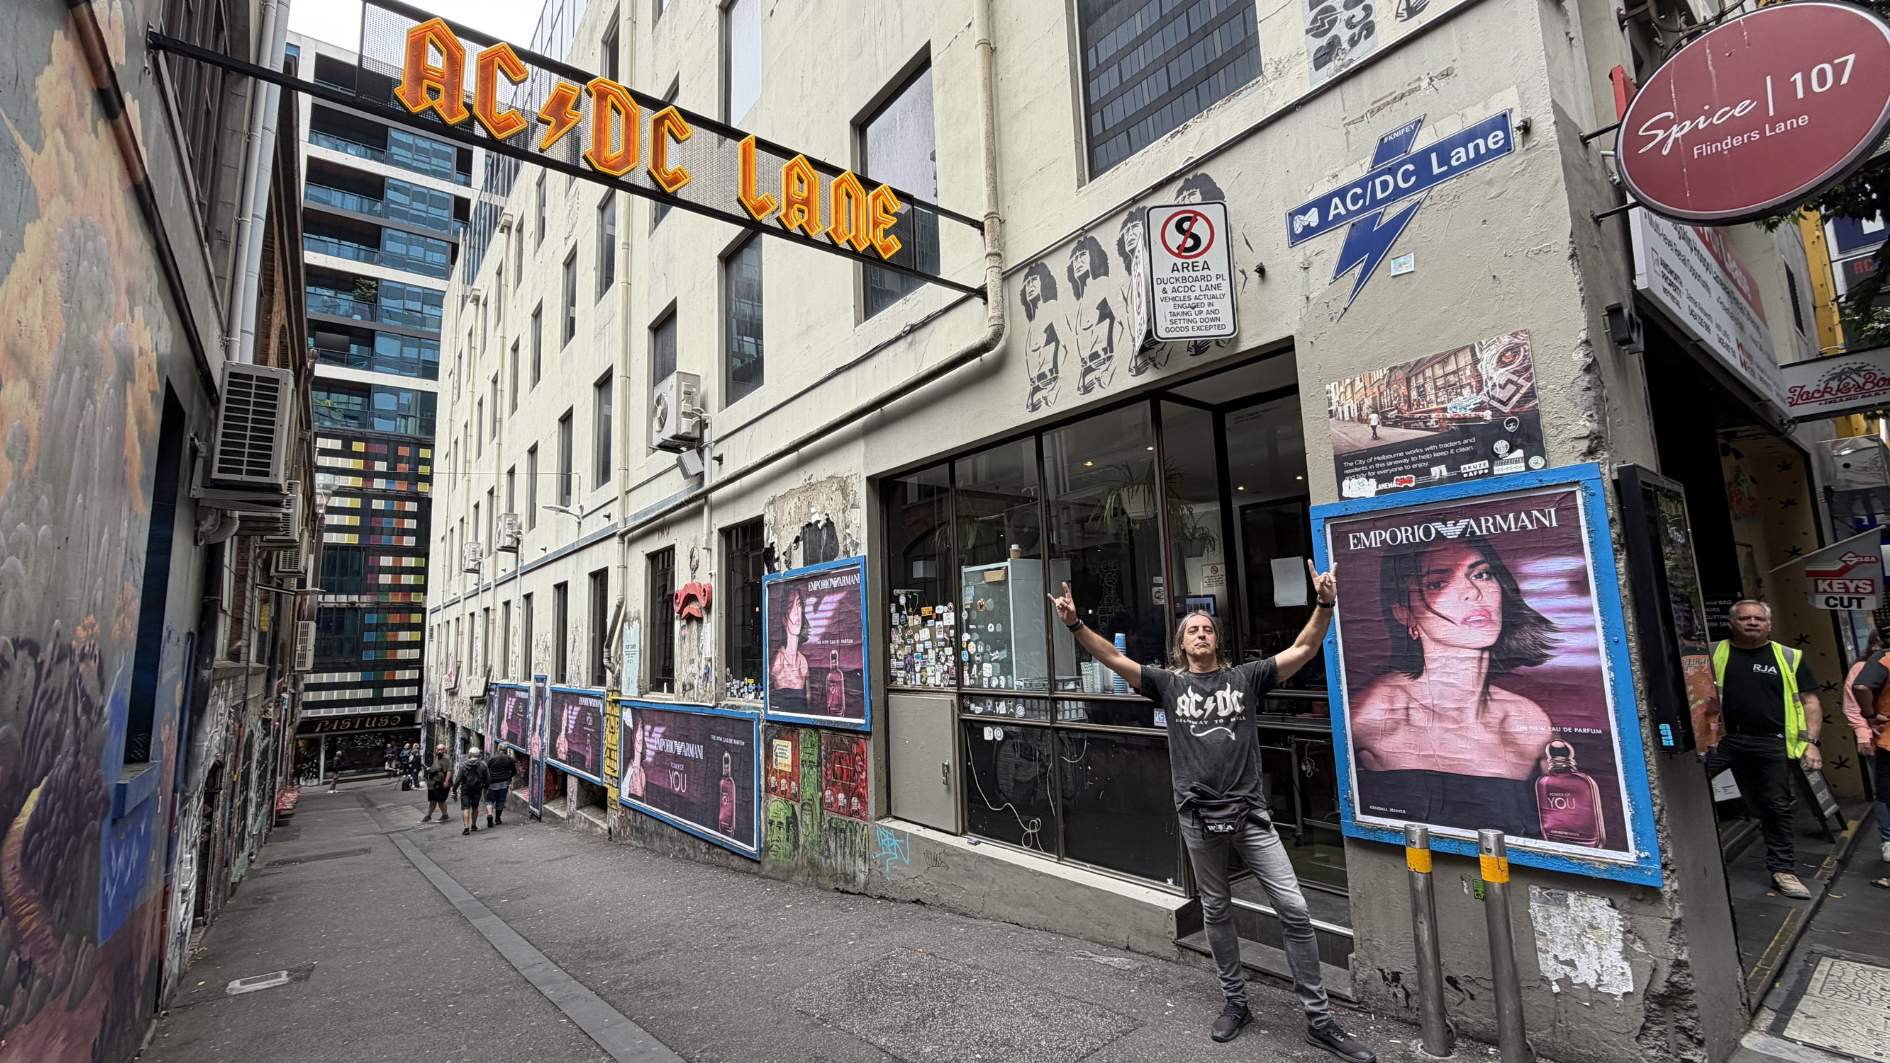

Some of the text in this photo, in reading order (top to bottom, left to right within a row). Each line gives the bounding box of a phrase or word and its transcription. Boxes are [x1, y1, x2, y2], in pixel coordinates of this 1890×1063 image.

[1637, 53, 1857, 156] Spice 107
[1382, 123, 1416, 144] #KNIFEY
[1693, 114, 1809, 159] Flinders Lane
[1327, 163, 1417, 221] AC/DC
[1430, 129, 1505, 175] Lane
[737, 134, 903, 261] LANE
[1171, 260, 1211, 273] AREA
[1156, 274, 1212, 285] DUCKBOARD
[1171, 284, 1196, 293] ACDC
[1199, 283, 1223, 292] LANE
[1160, 293, 1226, 303] VEHICLES ACTUALLY
[1173, 302, 1205, 310] ENGAGED
[1192, 324, 1226, 332] EXCEPTED
[1787, 382, 1838, 407] Jack
[1861, 371, 1890, 391] Bo
[1823, 396, 1859, 405] ISLAND
[1344, 466, 1369, 474] residents
[1386, 457, 1410, 467] laneway
[1419, 453, 1433, 461] help
[1433, 450, 1449, 458] keep
[1456, 445, 1474, 453] clean
[1354, 459, 1366, 467] City
[1373, 451, 1404, 462] Melbourne
[1405, 448, 1423, 456] works
[1424, 445, 1438, 453] with
[1438, 441, 1462, 449] traders
[1462, 437, 1476, 445] and
[1376, 466, 1404, 476] everyone
[1462, 462, 1487, 471] AKUZE
[1348, 508, 1559, 550] EMPORIO ARMANI
[808, 573, 860, 591] EMPORIO ARMANI
[1817, 579, 1873, 593] KEYS
[1825, 596, 1865, 609] CUT
[1753, 663, 1777, 674] RJA
[314, 715, 401, 732] PASTUSO
[654, 737, 704, 760] EMPORIO ARMANI
[668, 769, 687, 793] YOU
[1548, 797, 1576, 810] YOU
